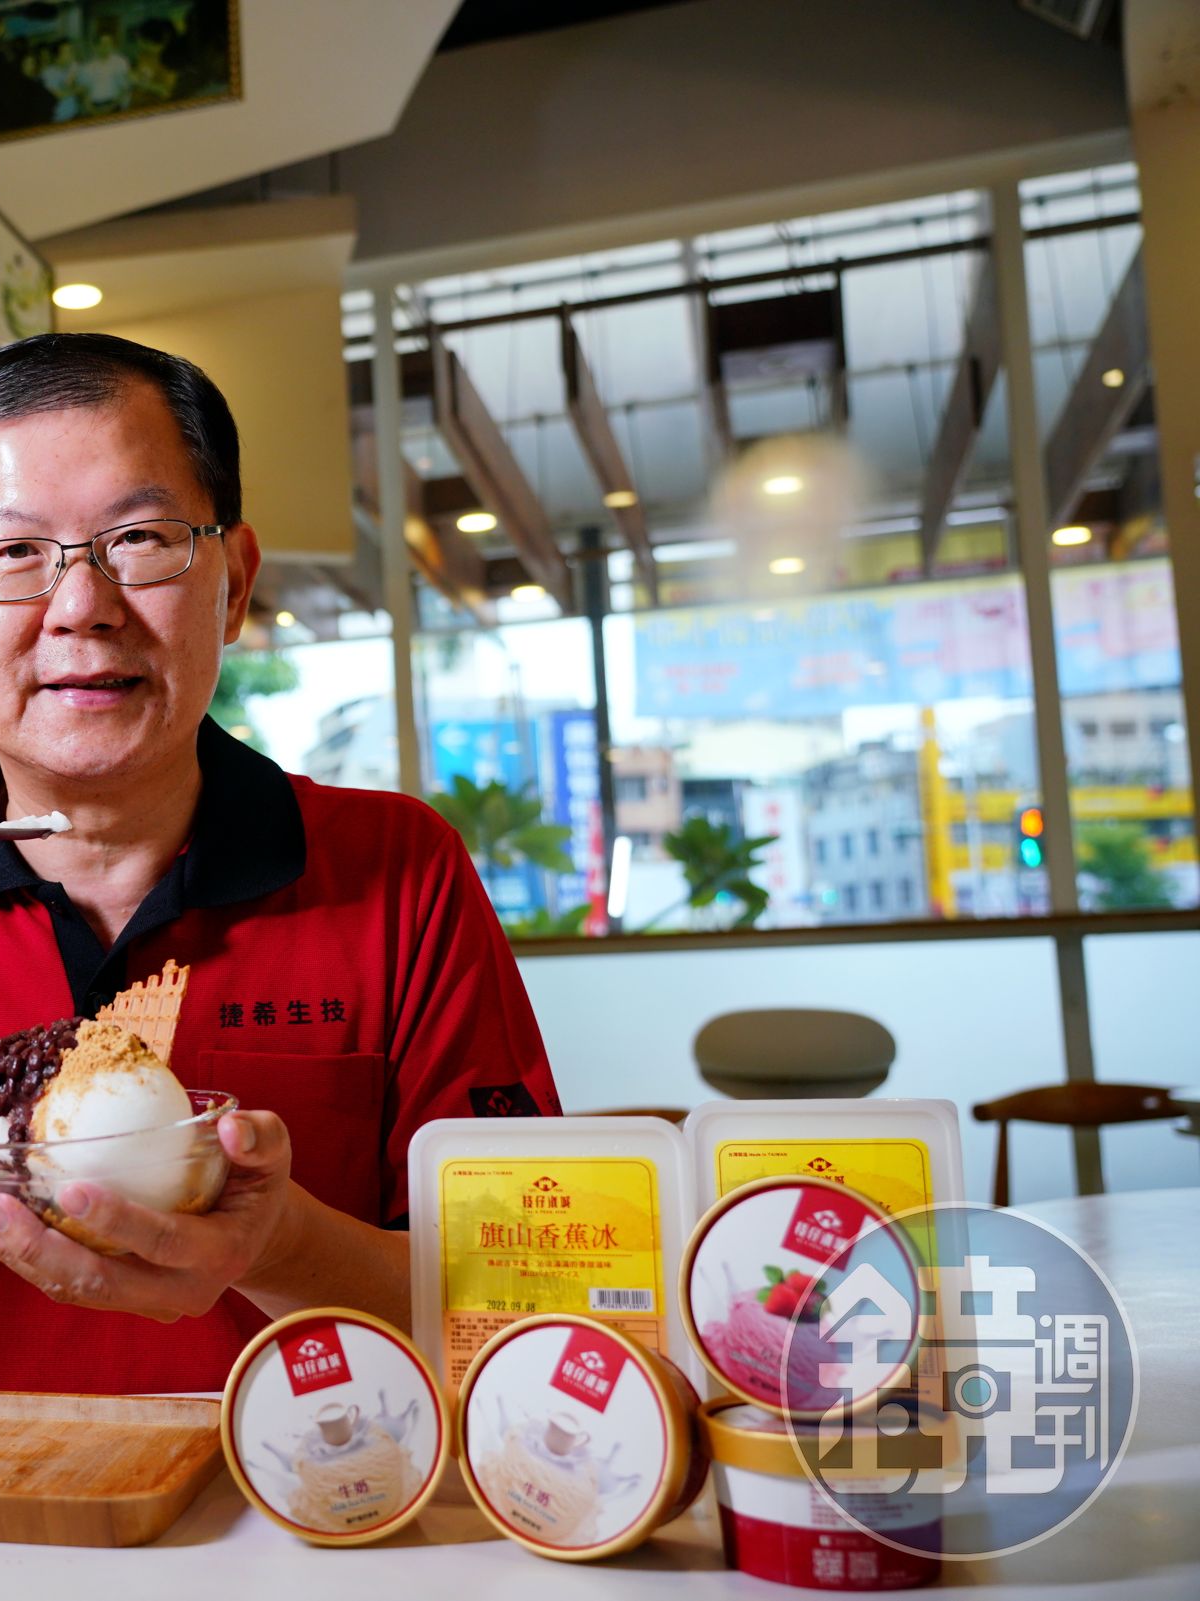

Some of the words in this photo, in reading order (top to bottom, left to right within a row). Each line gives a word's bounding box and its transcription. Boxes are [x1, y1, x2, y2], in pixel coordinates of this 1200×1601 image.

[219, 999, 347, 1028] 捷希生技
[479, 1221, 619, 1250] 旗山香蕉冰
[486, 1300, 536, 1313] 2022.09.08
[338, 1478, 370, 1498] 牛奶
[523, 1481, 552, 1507] 牛奶
